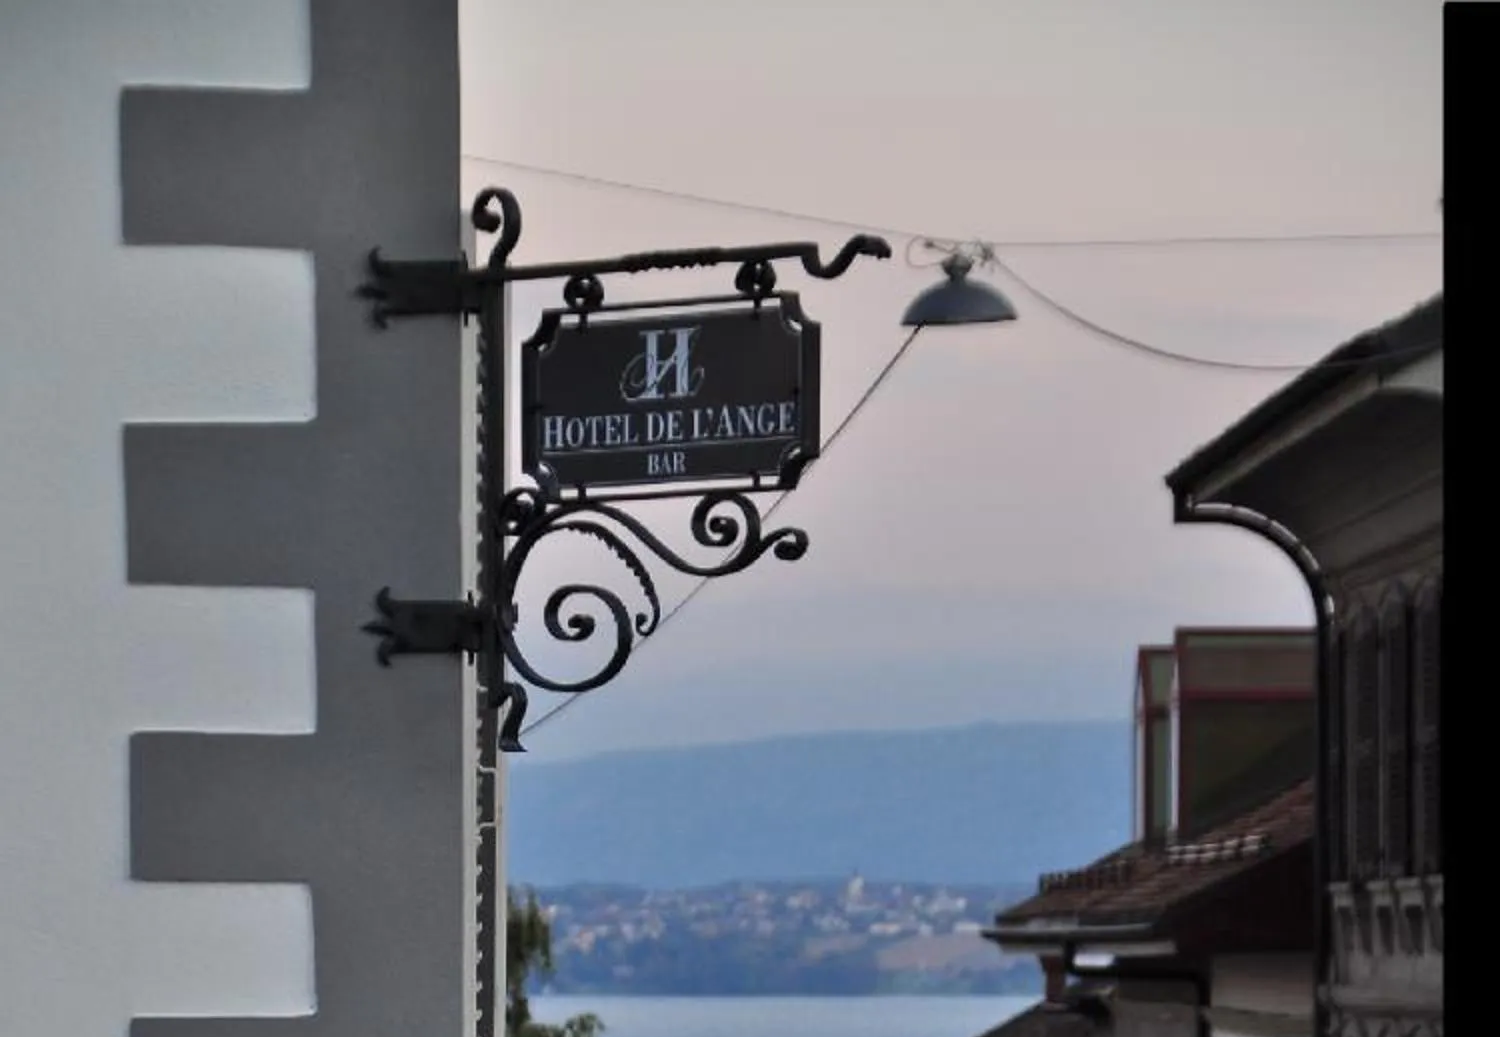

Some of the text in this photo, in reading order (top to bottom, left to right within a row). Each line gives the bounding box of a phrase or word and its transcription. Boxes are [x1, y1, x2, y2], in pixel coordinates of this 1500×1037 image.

[543, 402, 796, 449] HOTEL DE L'ANGE
[647, 452, 686, 475] BAR
